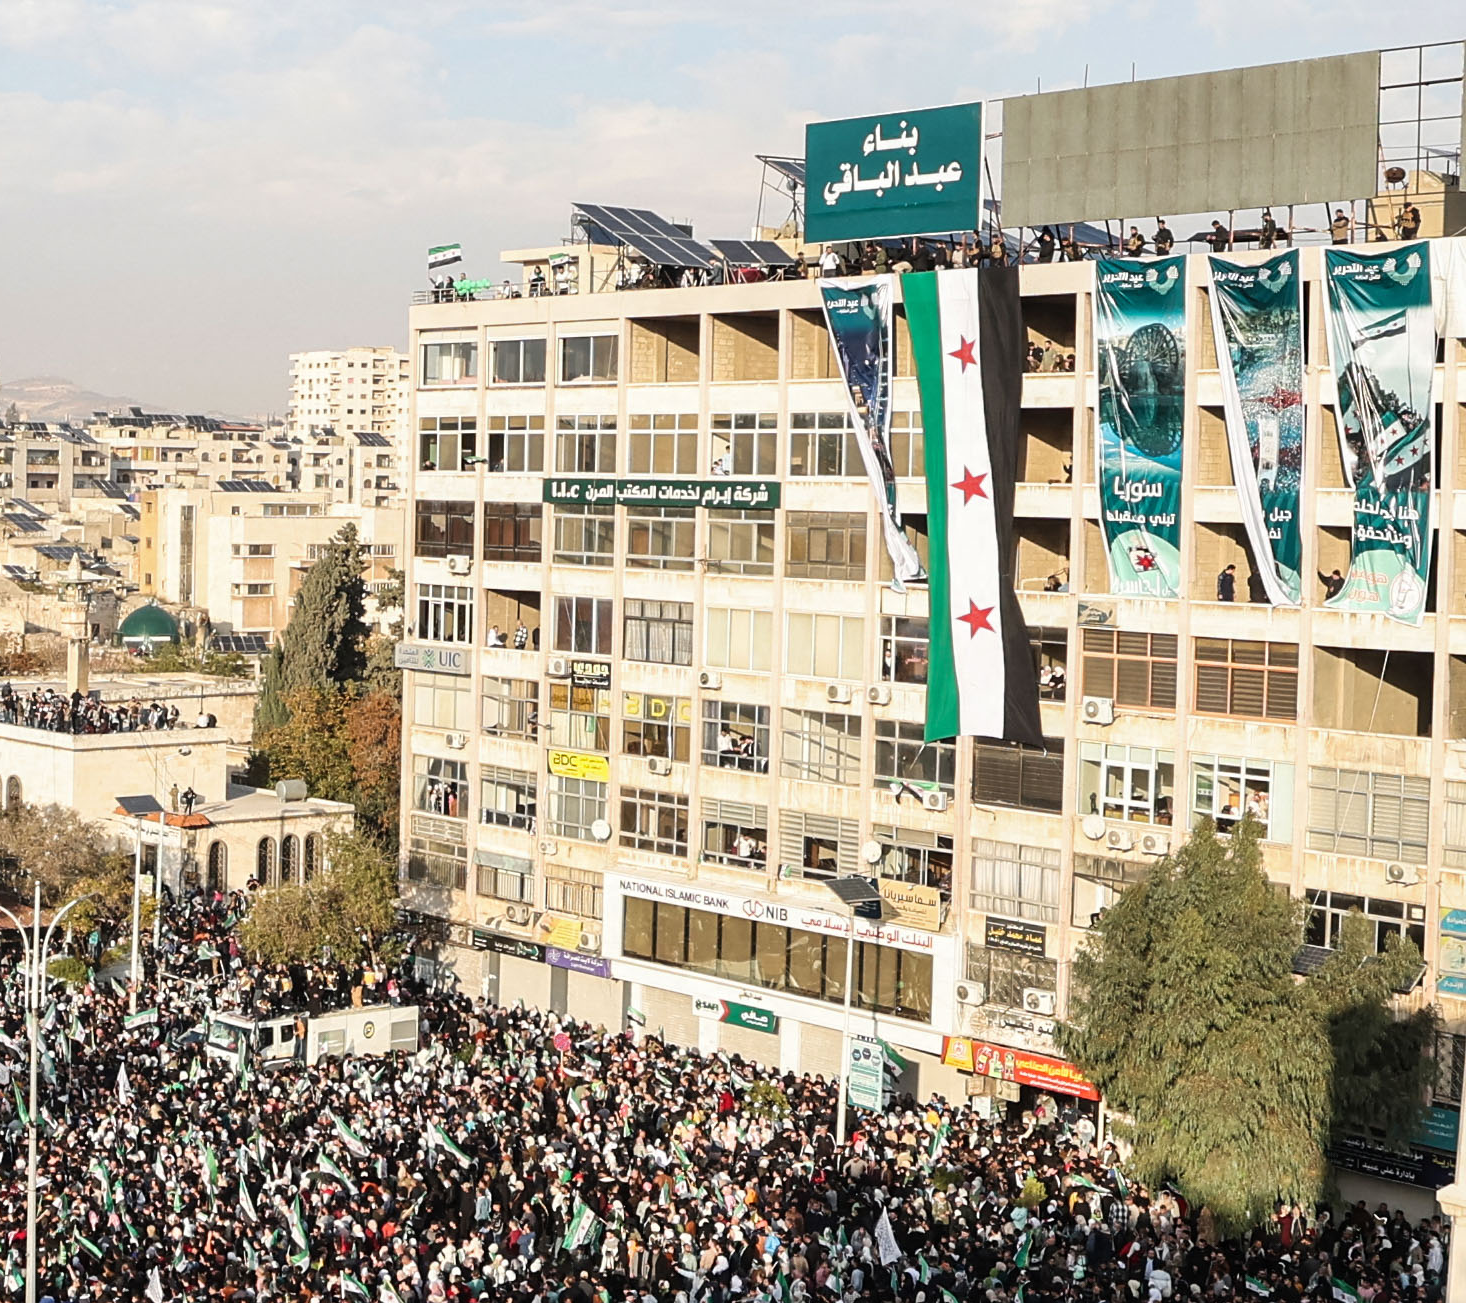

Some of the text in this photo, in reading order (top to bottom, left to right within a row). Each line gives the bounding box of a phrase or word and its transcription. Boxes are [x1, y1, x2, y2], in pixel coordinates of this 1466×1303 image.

[863, 120, 919, 157] بناء
[823, 159, 962, 206] عبد الباقي
[616, 482, 657, 500] المكتب
[658, 484, 700, 500] لخدمات
[733, 483, 768, 506] شركة
[1114, 476, 1163, 502] سوريا
[1149, 513, 1176, 527] تبني
[439, 651, 461, 668] UIC
[619, 880, 729, 909] NATIONAL ISLAMIC BANK
[766, 908, 788, 921] NIB
[857, 924, 900, 943] الوطني
[903, 932, 933, 948] البنك
